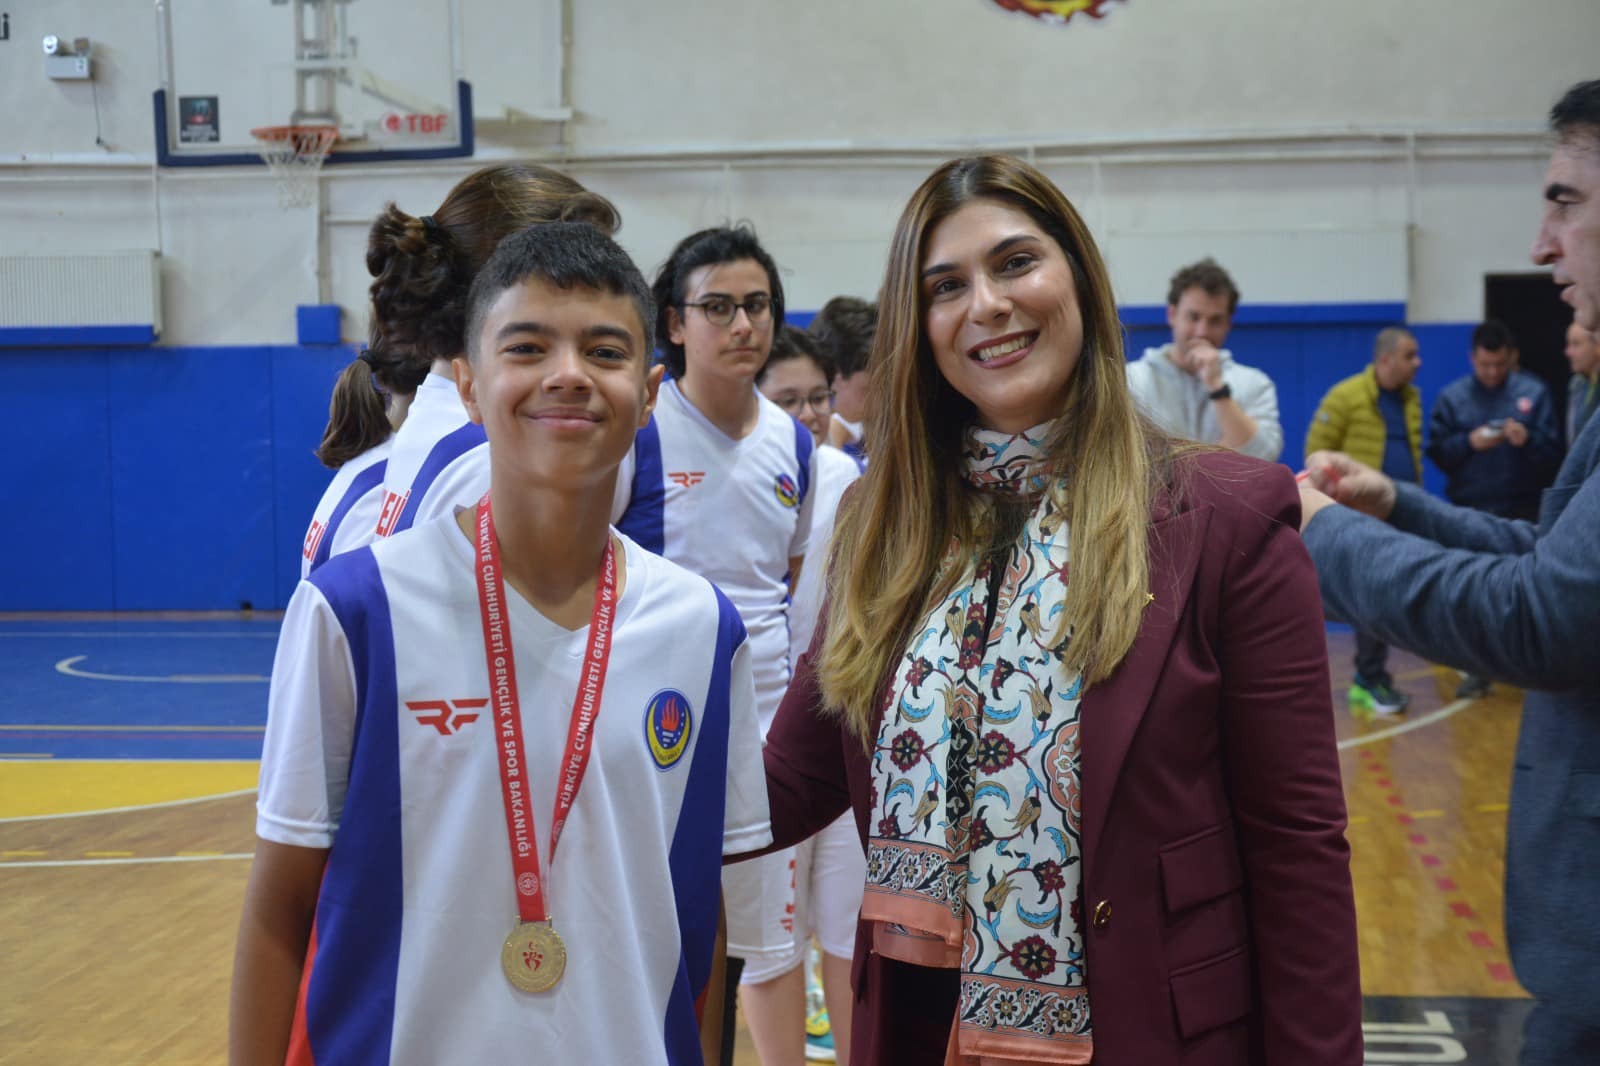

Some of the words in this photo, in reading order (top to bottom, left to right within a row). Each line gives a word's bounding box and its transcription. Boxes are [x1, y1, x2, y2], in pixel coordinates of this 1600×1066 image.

[404, 112, 449, 135] TBF
[375, 488, 411, 537] ELİ
[480, 511, 492, 562] TÜRKİYE
[483, 565, 506, 653] CUMHURİYETİ
[495, 657, 513, 716] GENÇLİK
[561, 754, 582, 809] TÜRKİYE
[574, 661, 601, 751] CUMHURİYETİ
[593, 604, 611, 659] GENÇLİK
[602, 586, 612, 601] VE
[501, 720, 514, 737] VE
[504, 741, 519, 777] SPOR
[509, 781, 531, 857] BAKANLIĞI
